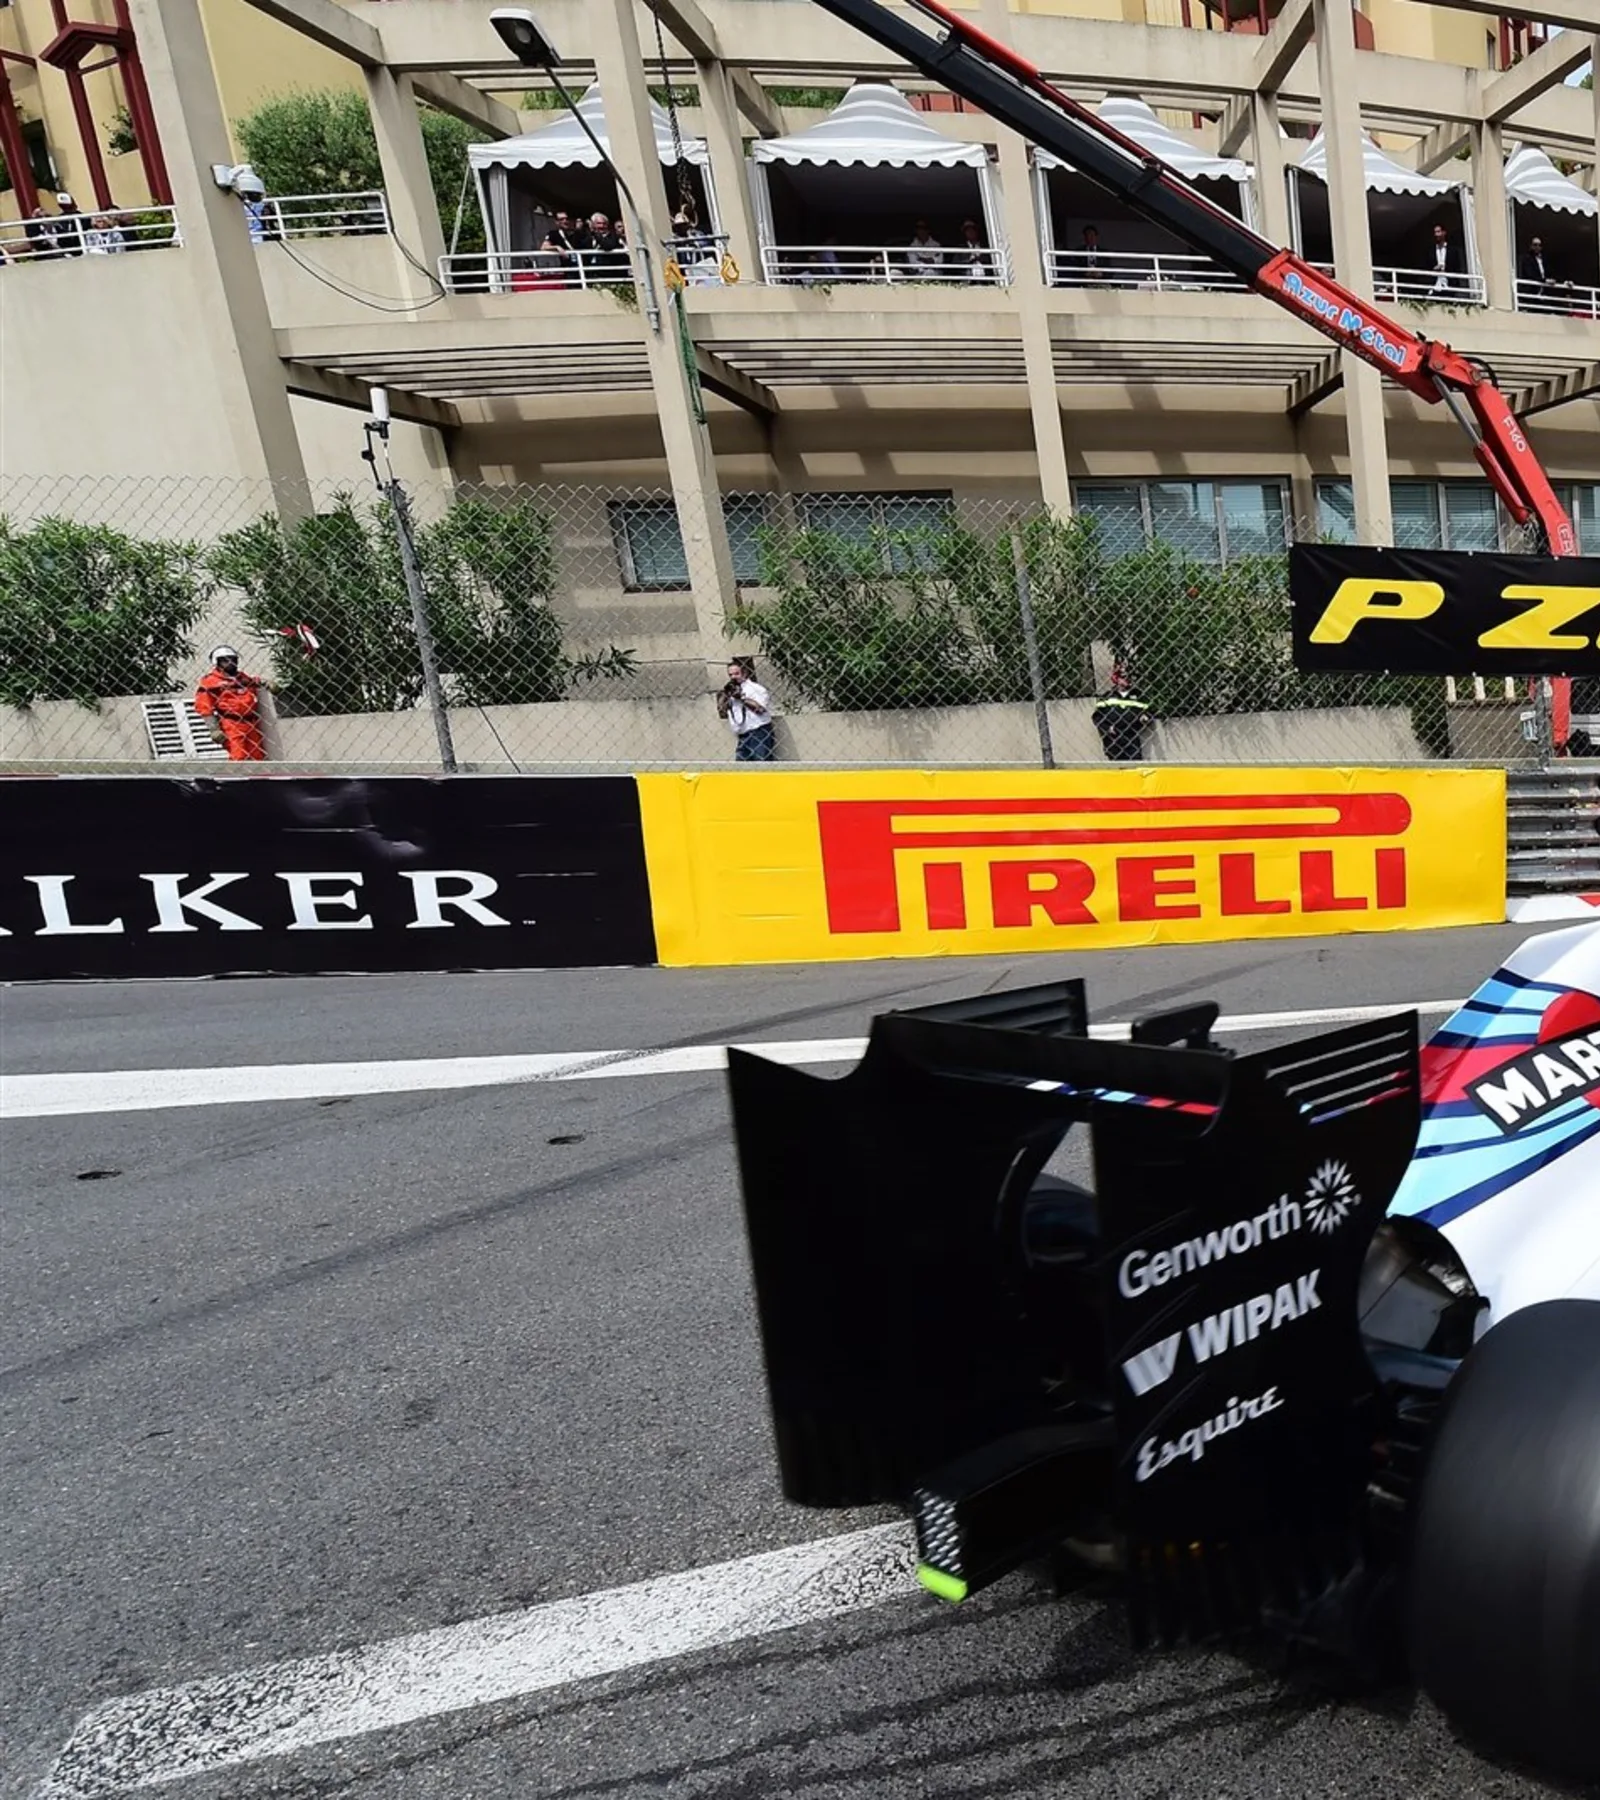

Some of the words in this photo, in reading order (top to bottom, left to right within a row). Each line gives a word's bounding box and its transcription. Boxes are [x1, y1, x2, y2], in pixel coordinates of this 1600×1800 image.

[1283, 272, 1339, 320] Azur
[1338, 308, 1407, 367] Métal
[1309, 578, 1445, 643] P
[0, 870, 511, 936] LKER
[817, 792, 1412, 934] PIRELLI
[1118, 1194, 1302, 1299] Genworth
[1188, 1268, 1323, 1364] WIPAK
[1134, 1386, 1286, 1482] Esquire
